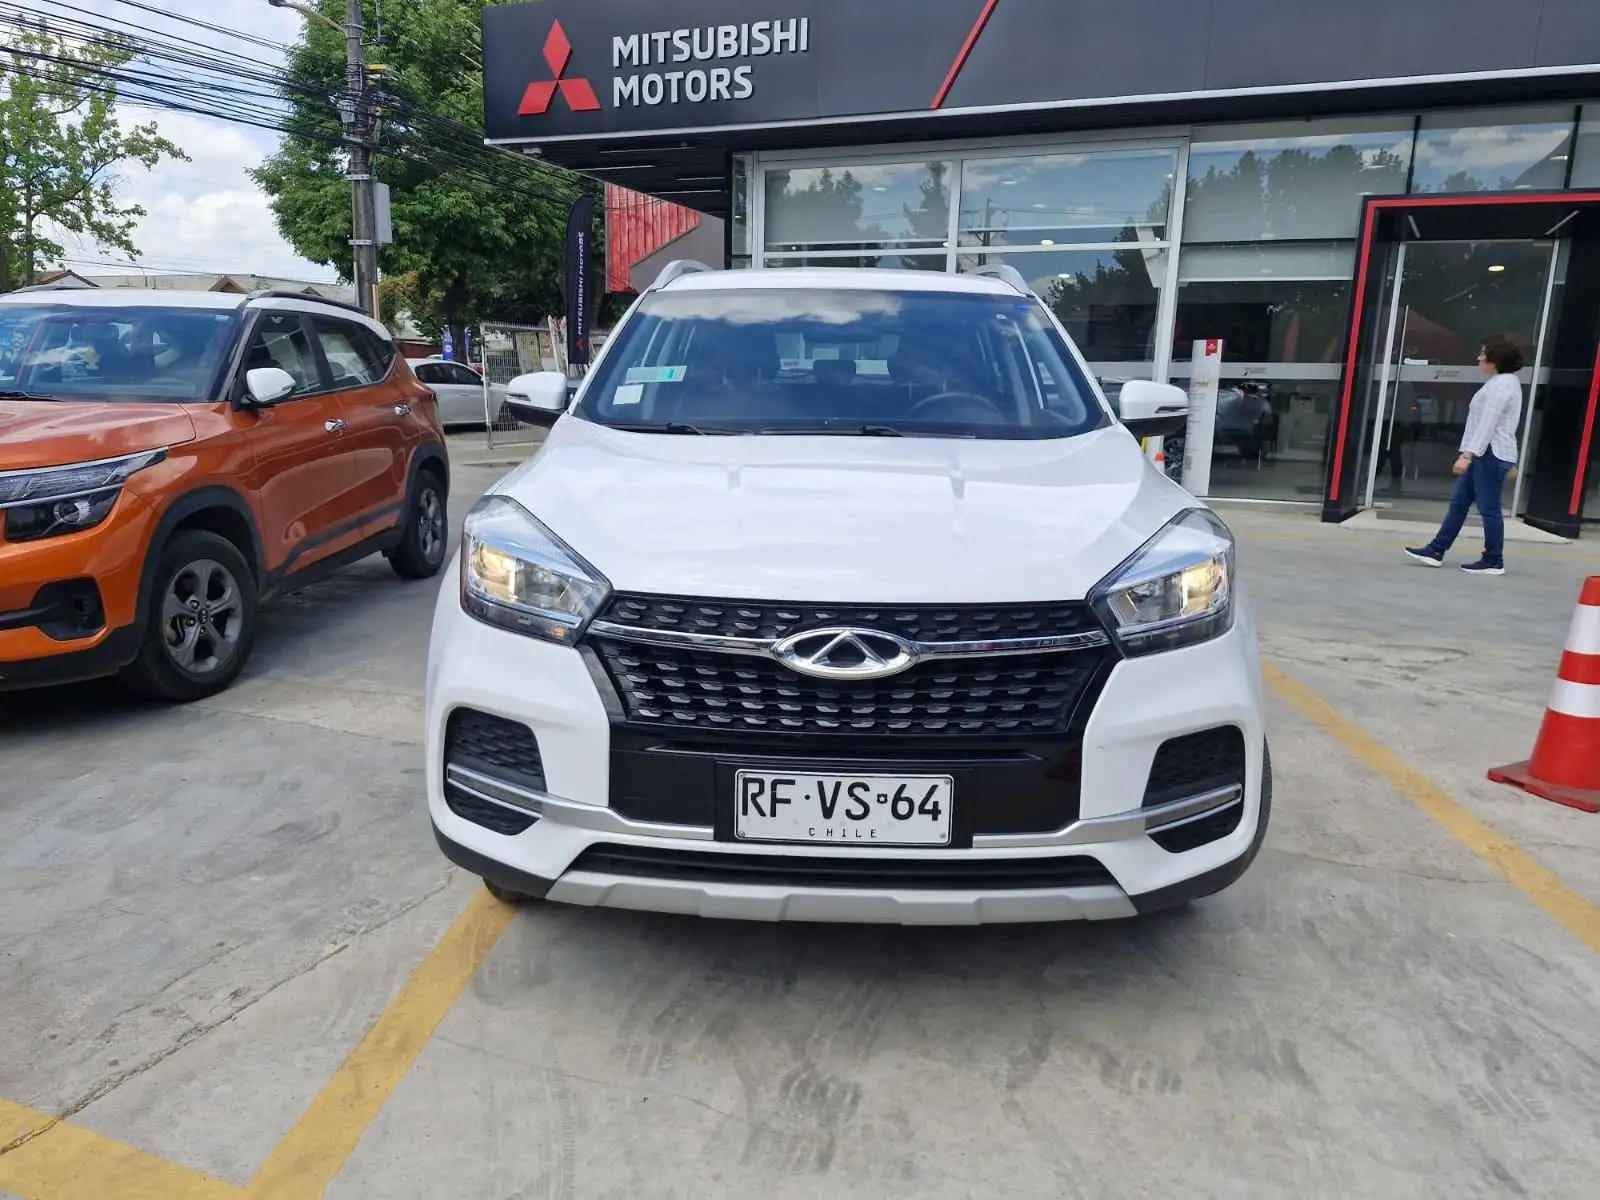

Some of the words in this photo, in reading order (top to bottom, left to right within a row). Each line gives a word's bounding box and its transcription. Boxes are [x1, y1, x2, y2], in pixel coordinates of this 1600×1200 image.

[612, 17, 809, 67] MITSUBISHI
[612, 65, 753, 107] MOTORS
[808, 827, 877, 838] CHILE
